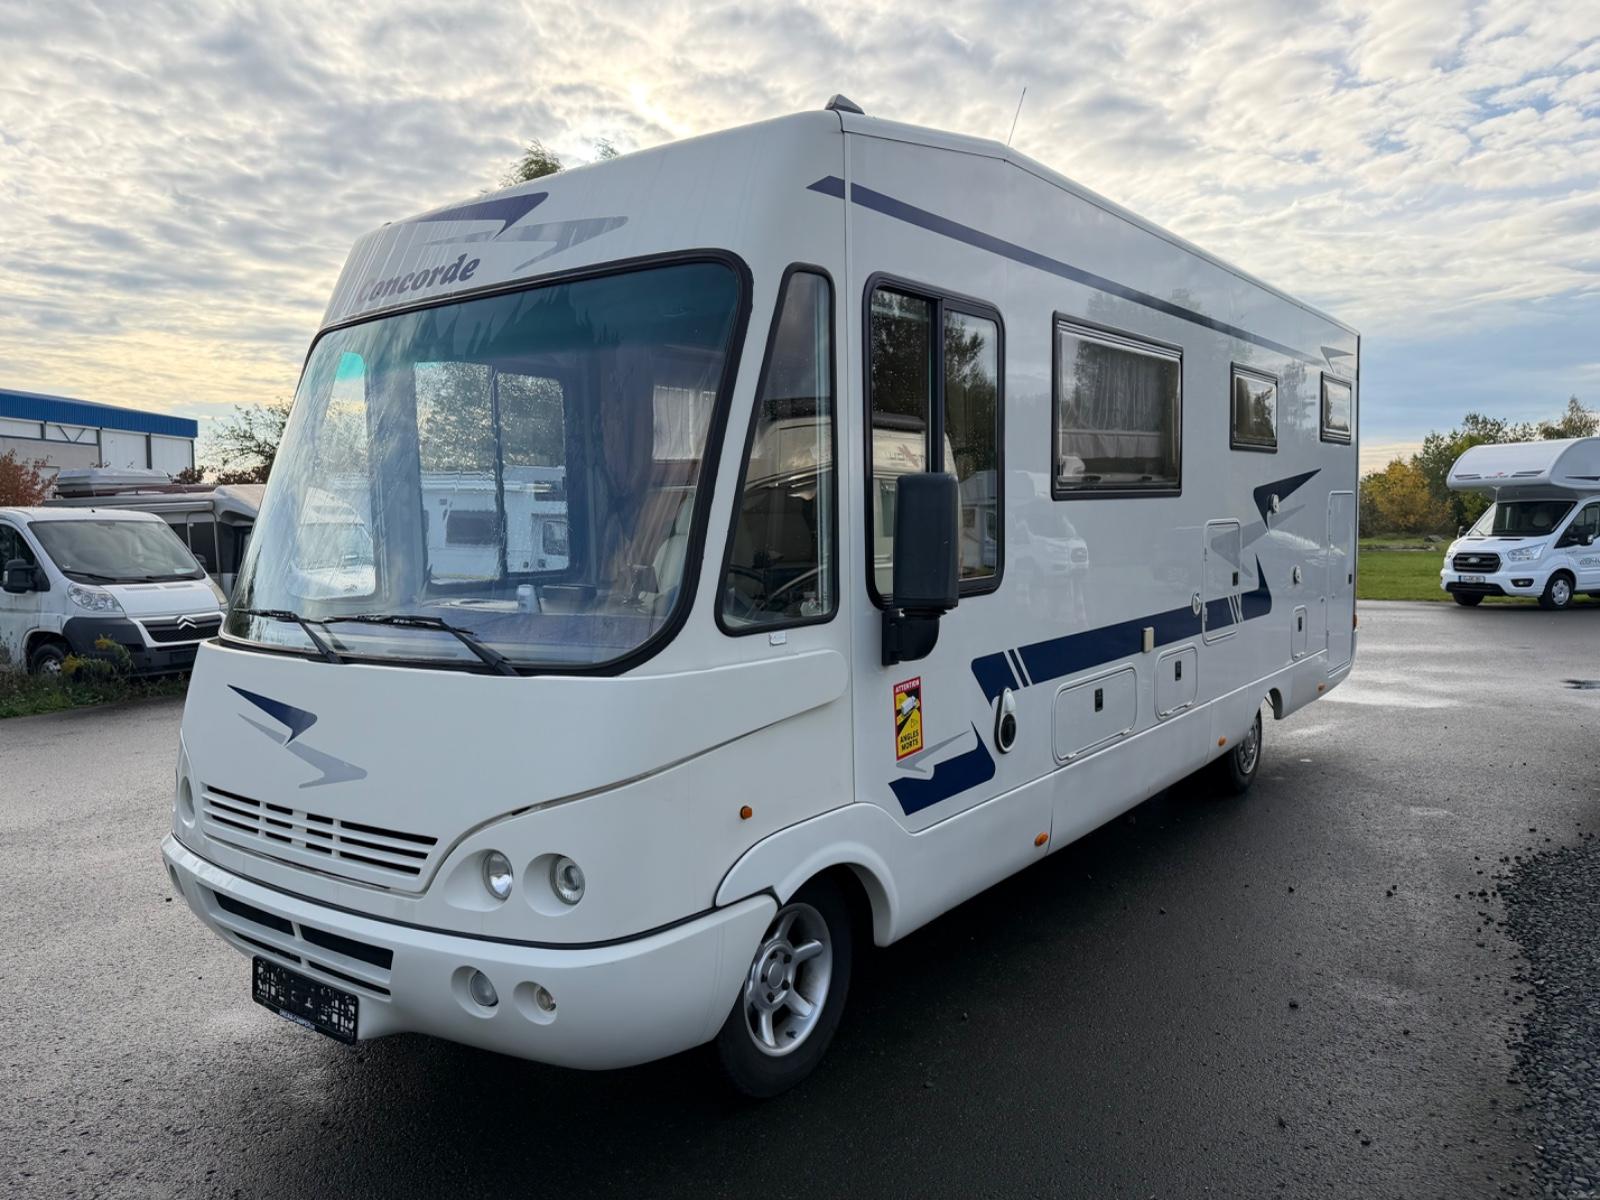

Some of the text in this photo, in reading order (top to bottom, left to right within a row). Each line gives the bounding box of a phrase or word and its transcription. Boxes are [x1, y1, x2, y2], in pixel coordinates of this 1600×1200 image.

[357, 253, 481, 302] Concorde
[895, 679, 920, 693] ATTENTION
[900, 729, 919, 743] ANGLES
[901, 739, 919, 752] MORTS
